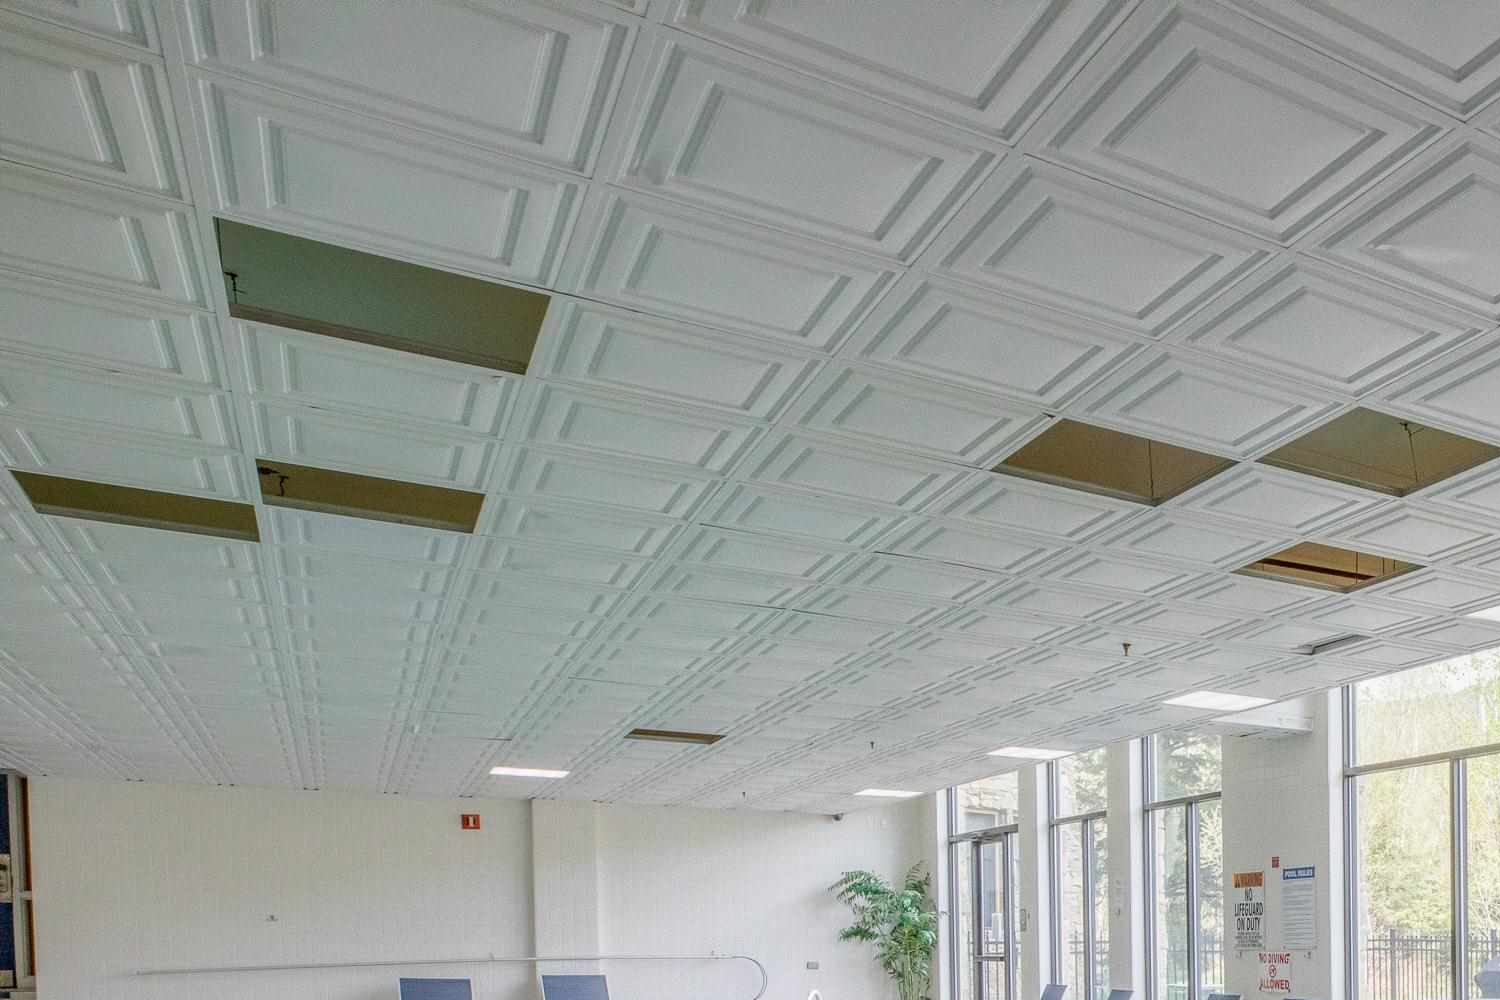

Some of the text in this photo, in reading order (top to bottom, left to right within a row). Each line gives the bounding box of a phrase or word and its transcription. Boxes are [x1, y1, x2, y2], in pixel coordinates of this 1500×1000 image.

[1244, 888, 1253, 901] NO
[1234, 902, 1264, 917] LIFEGUARD
[1236, 917, 1260, 931] ON DUTY
[1258, 953, 1290, 964] NO DIVING
[1259, 979, 1290, 990] ALLOWED
